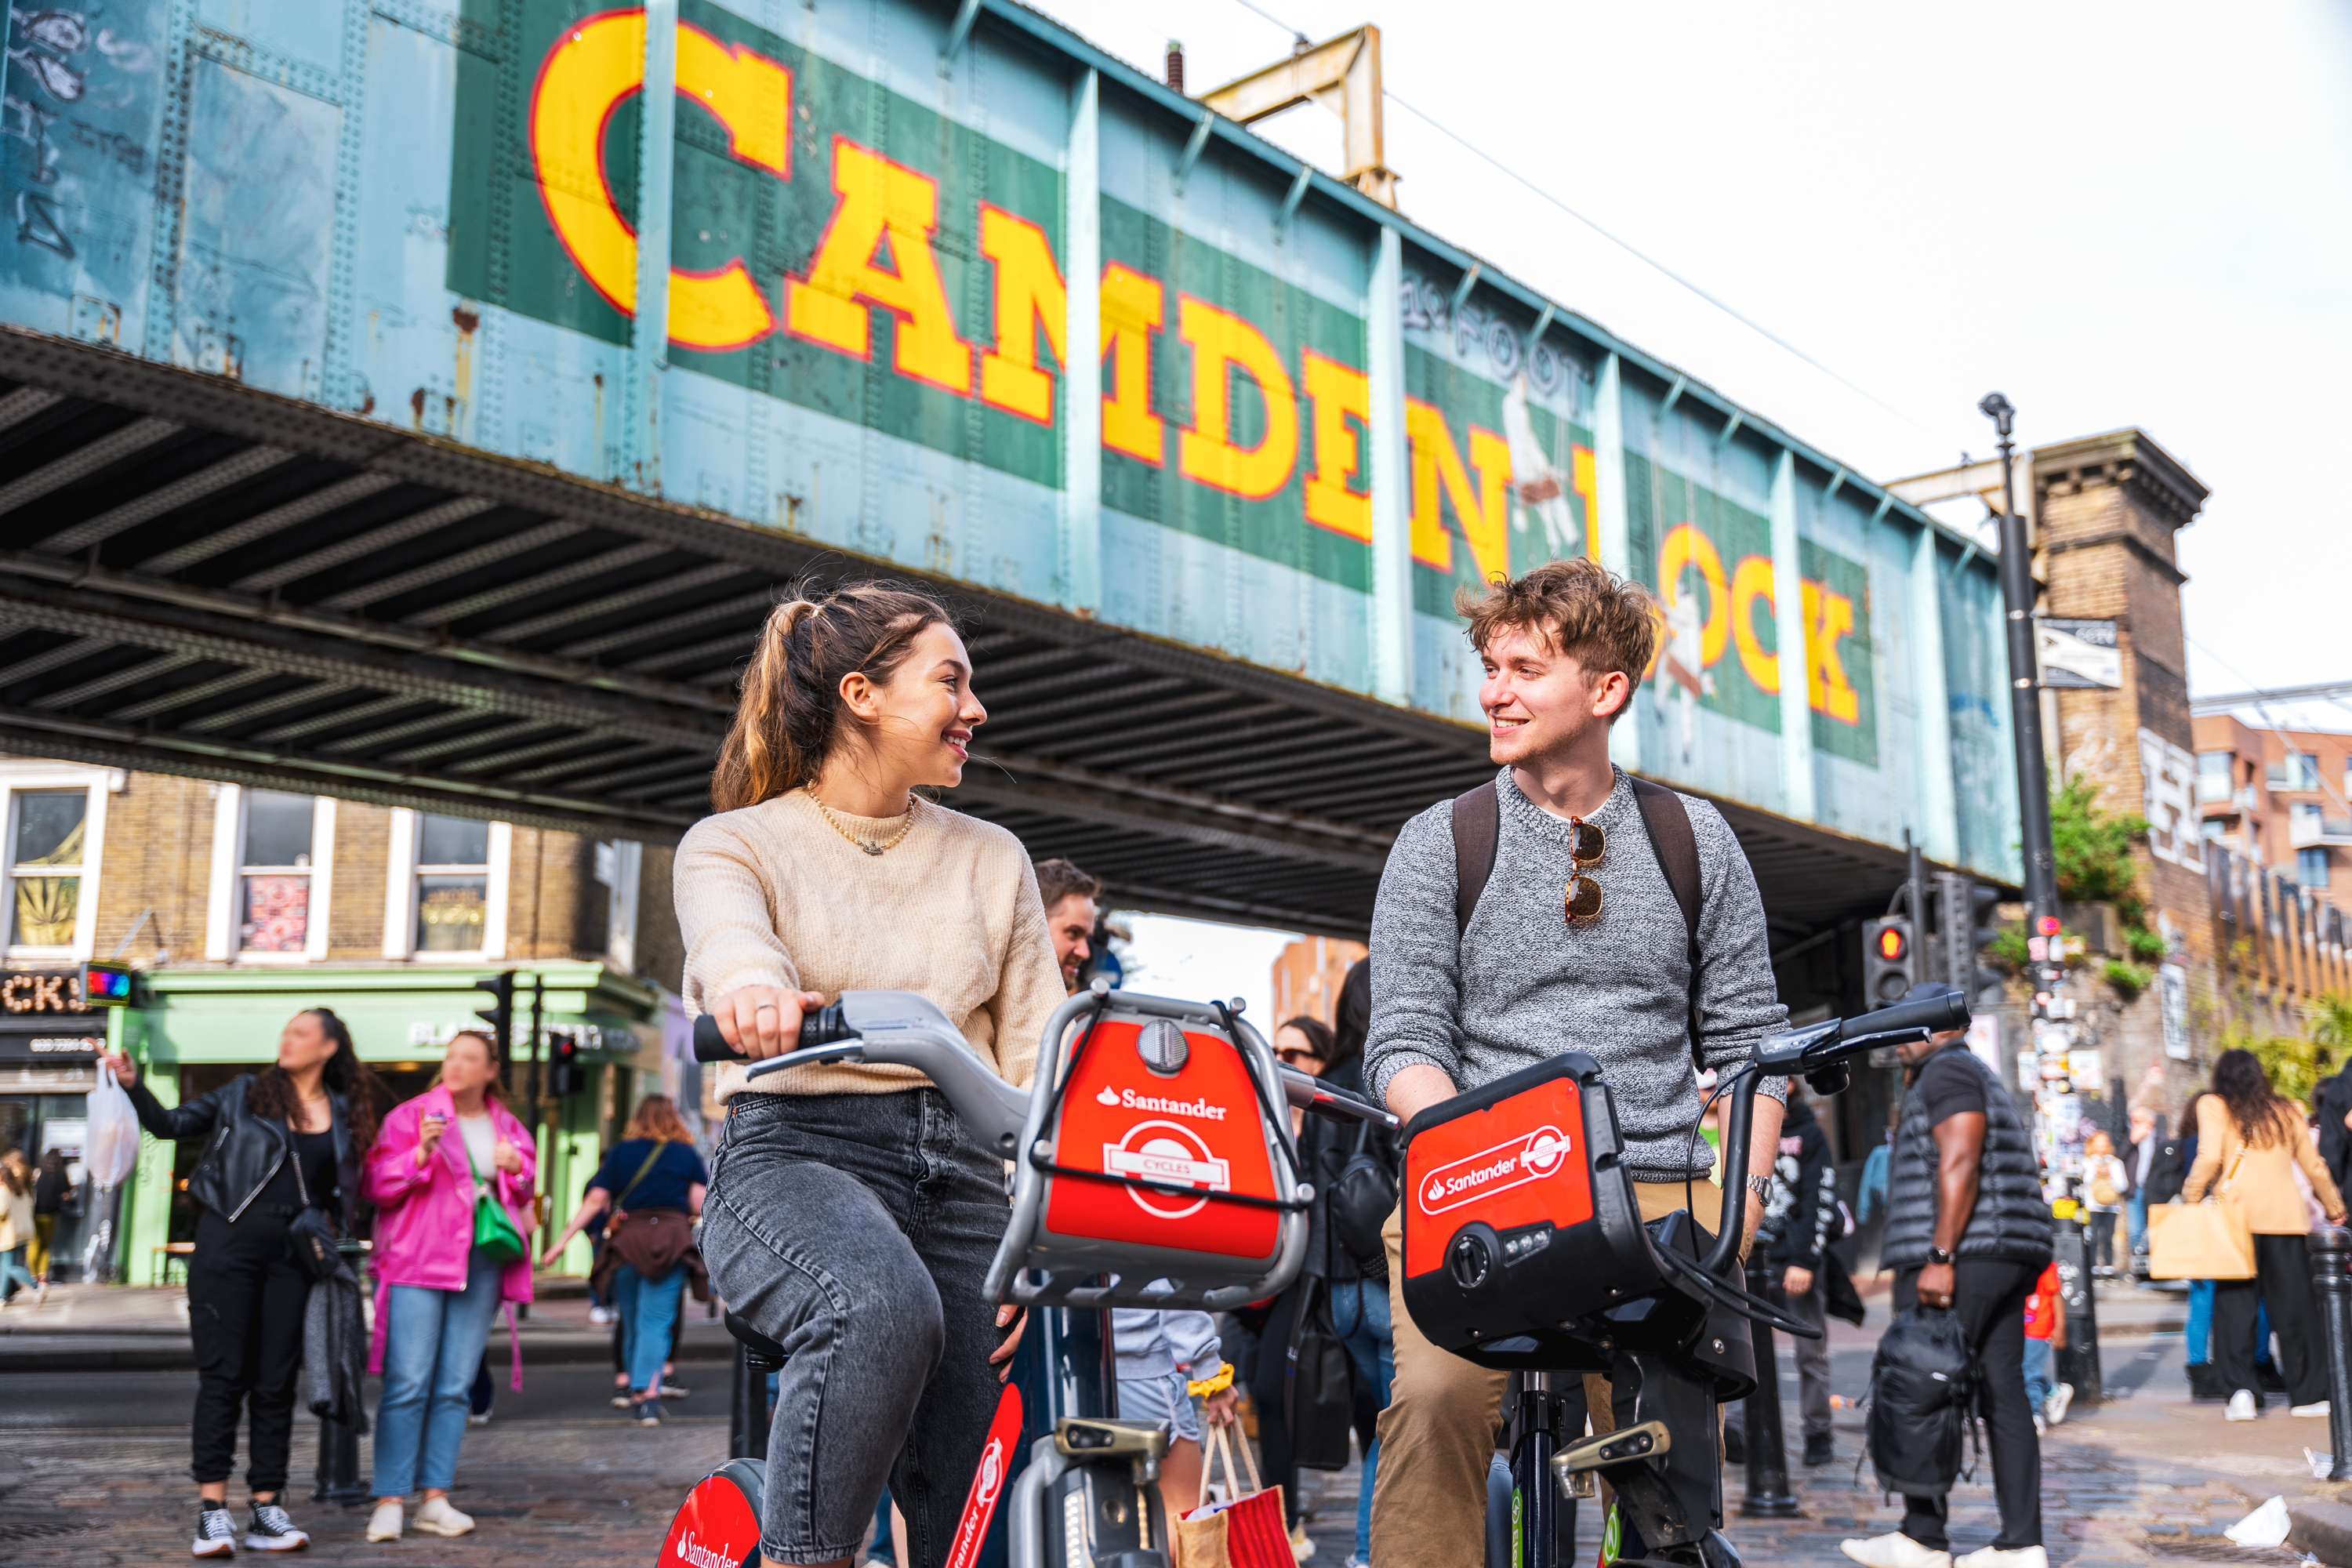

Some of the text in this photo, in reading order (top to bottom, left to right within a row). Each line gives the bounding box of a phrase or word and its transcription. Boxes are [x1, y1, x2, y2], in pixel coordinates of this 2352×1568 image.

[528, 8, 1513, 590] CAMDEN
[1122, 1088, 1227, 1121] Santander
[1143, 1159, 1192, 1174] CYCLES
[1446, 1156, 1516, 1195] Santander
[953, 1506, 978, 1568] ander
